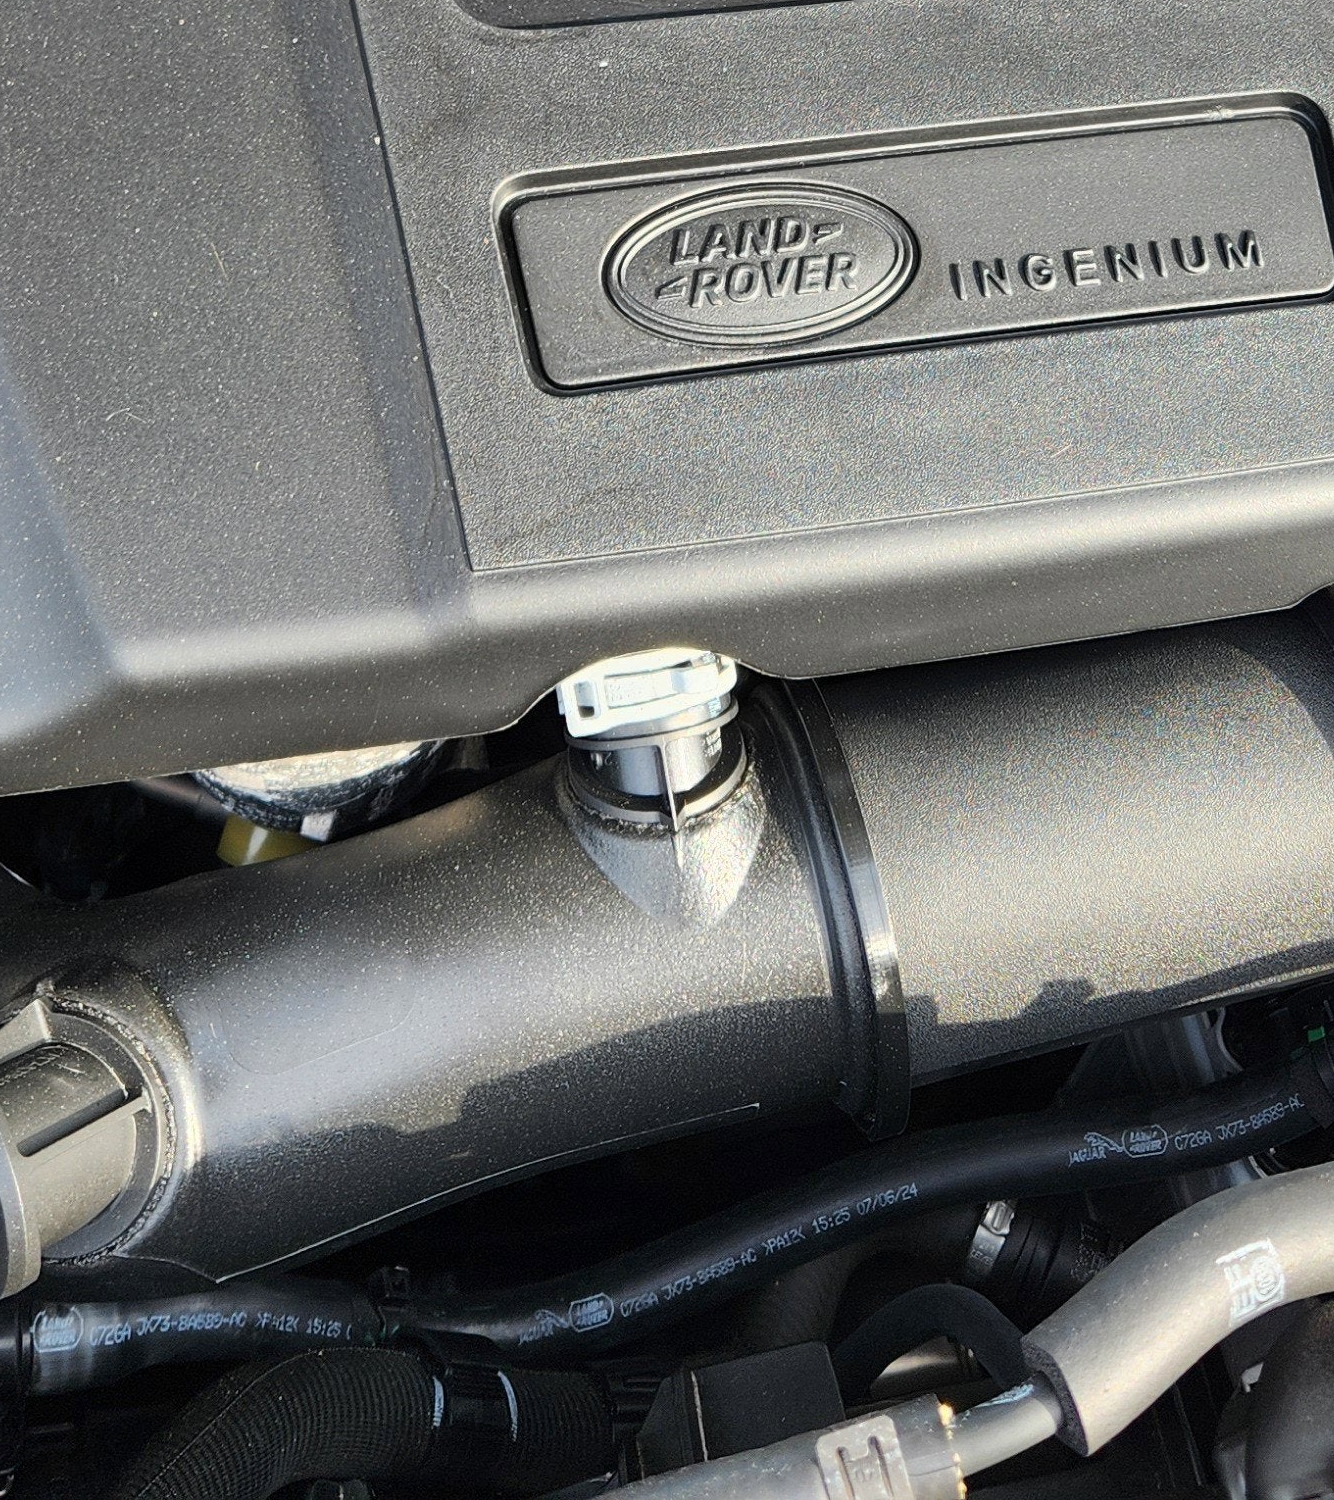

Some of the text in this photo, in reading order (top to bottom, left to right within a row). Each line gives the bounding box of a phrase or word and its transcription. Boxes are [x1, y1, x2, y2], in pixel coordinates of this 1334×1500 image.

[668, 216, 813, 268] LAND
[948, 229, 1265, 301] INGENIUM
[689, 251, 859, 309] ROVER
[811, 1206, 852, 1235] 15:25
[856, 1182, 919, 1217] 07/06/24
